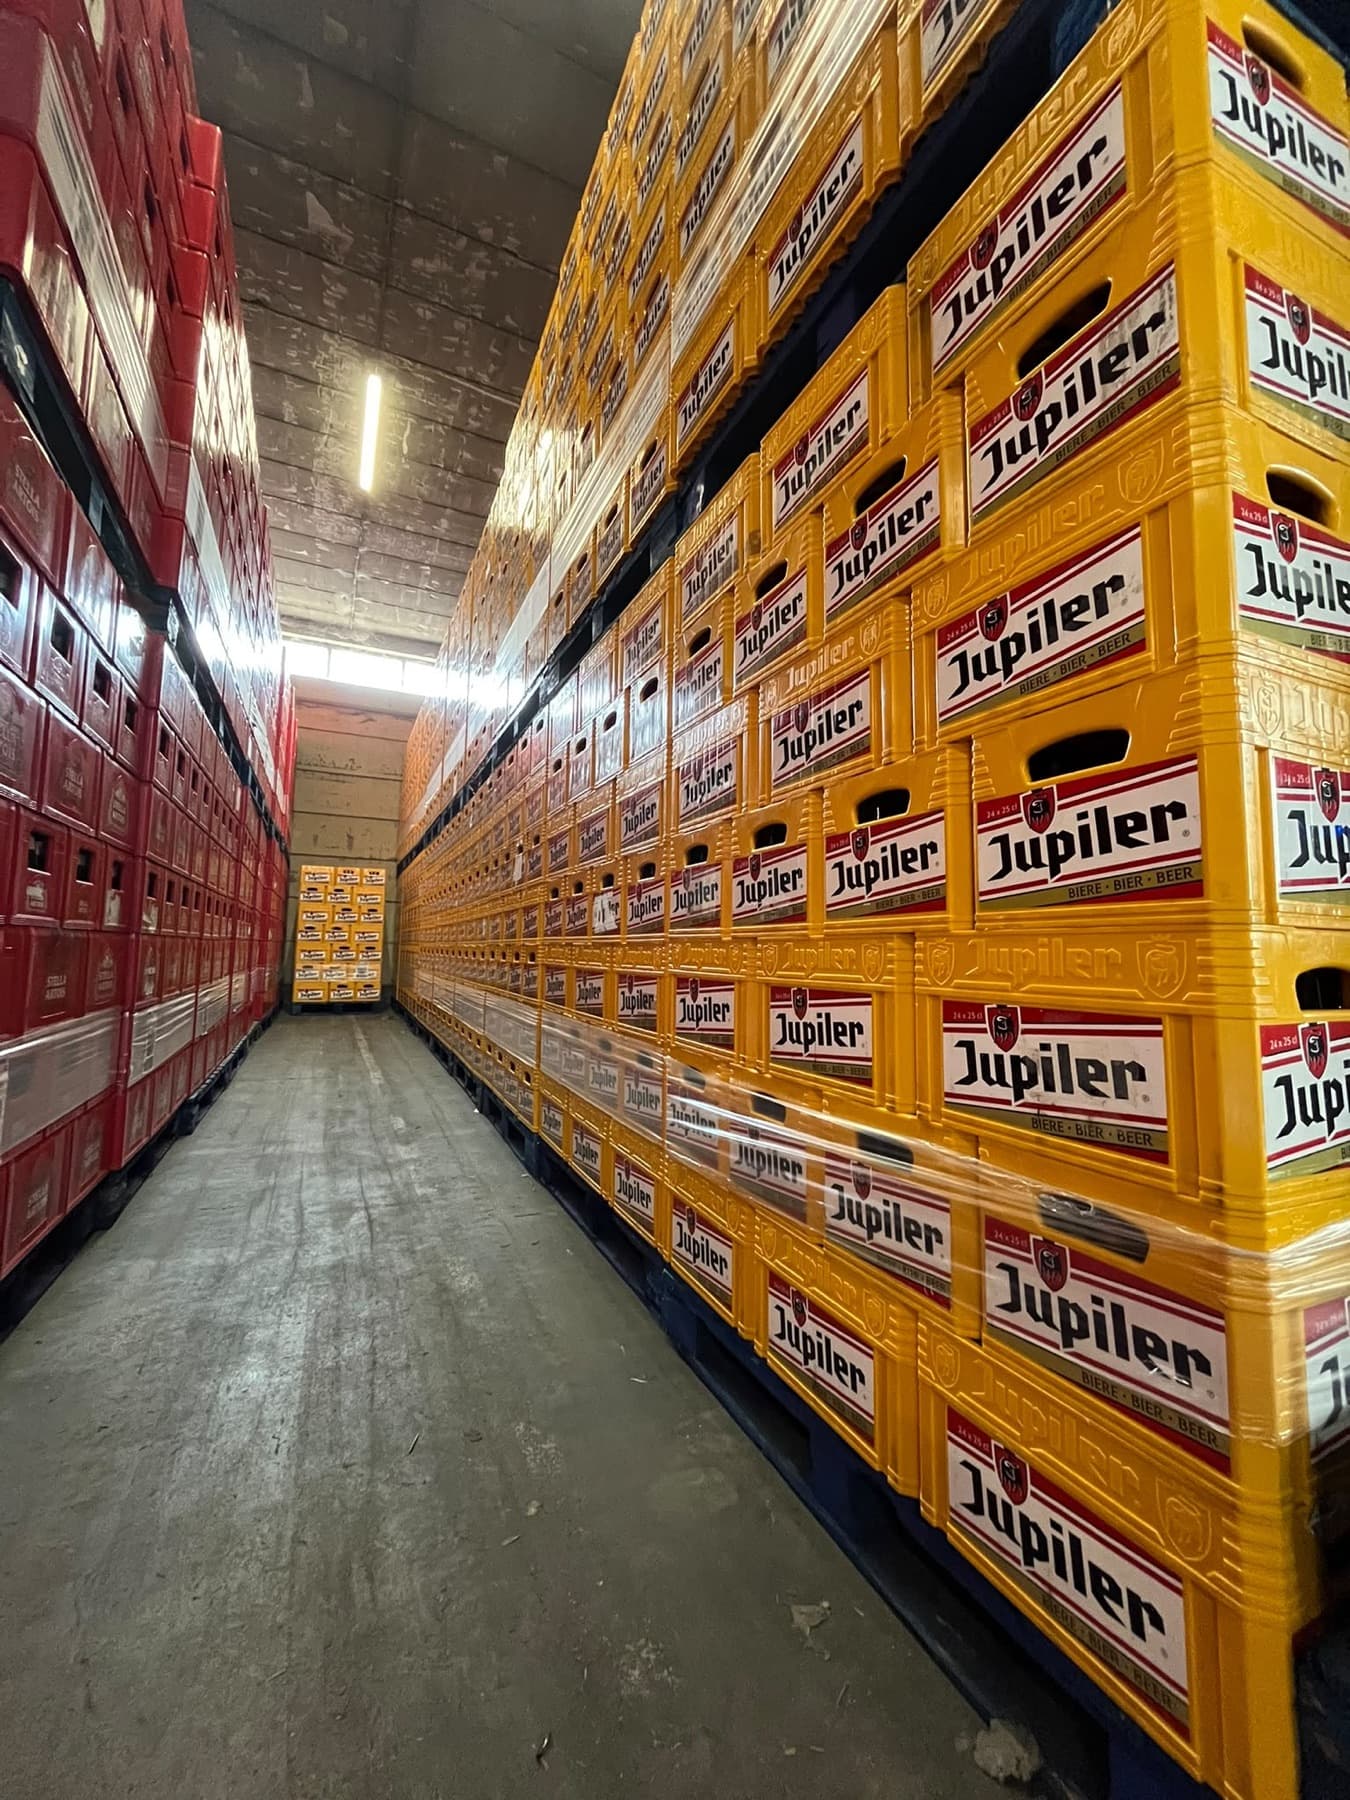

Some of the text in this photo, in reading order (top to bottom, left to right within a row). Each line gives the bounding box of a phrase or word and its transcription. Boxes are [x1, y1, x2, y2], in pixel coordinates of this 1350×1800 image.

[1218, 70, 1345, 186] Jupiler
[685, 136, 731, 246] Jupiler
[774, 149, 856, 299] Jupiler
[942, 135, 1107, 346] Jupiler
[681, 341, 730, 429] Jupiler
[1259, 315, 1350, 401] Jupil
[980, 311, 1166, 493] Jupiler
[1055, 364, 1172, 464] BIERE BIER BEER
[779, 400, 861, 514] Jupiler
[686, 534, 734, 605] Jupiler
[831, 490, 933, 600] Jupiler
[738, 592, 803, 666] Jupiler
[947, 575, 1125, 700] Jupiler
[1020, 633, 1130, 695] BIERE BIER BEER
[777, 699, 863, 772] Jupiler
[623, 801, 656, 837] Jupiler
[683, 762, 732, 810] Jupiler
[831, 840, 938, 896] Jupiler
[988, 801, 1187, 882] Jupiler
[629, 895, 662, 922] Jupiler
[673, 881, 718, 914] Jupiler
[736, 867, 803, 909] Jupiler
[1068, 867, 1192, 899] BIERE BIER BEER
[578, 982, 601, 1003] Jupiler
[620, 989, 654, 1016] Jupiler
[680, 997, 730, 1029] Jupiler
[776, 1012, 864, 1054] Jupiler
[626, 1081, 660, 1113] Jupiler
[954, 1040, 1147, 1103] Jupiler
[735, 1139, 803, 1184] Jupiler
[1031, 1119, 1153, 1147] BIERE BIER BEER
[617, 1172, 651, 1209] Jupiler
[830, 1184, 944, 1256] Jupiler
[676, 1221, 728, 1277] Jupiler
[775, 1304, 866, 1394] Jupiler
[995, 1262, 1212, 1389] Jupiler
[1081, 1370, 1218, 1449] BIERE BIER BEER
[960, 1460, 1165, 1643] Jupiler
